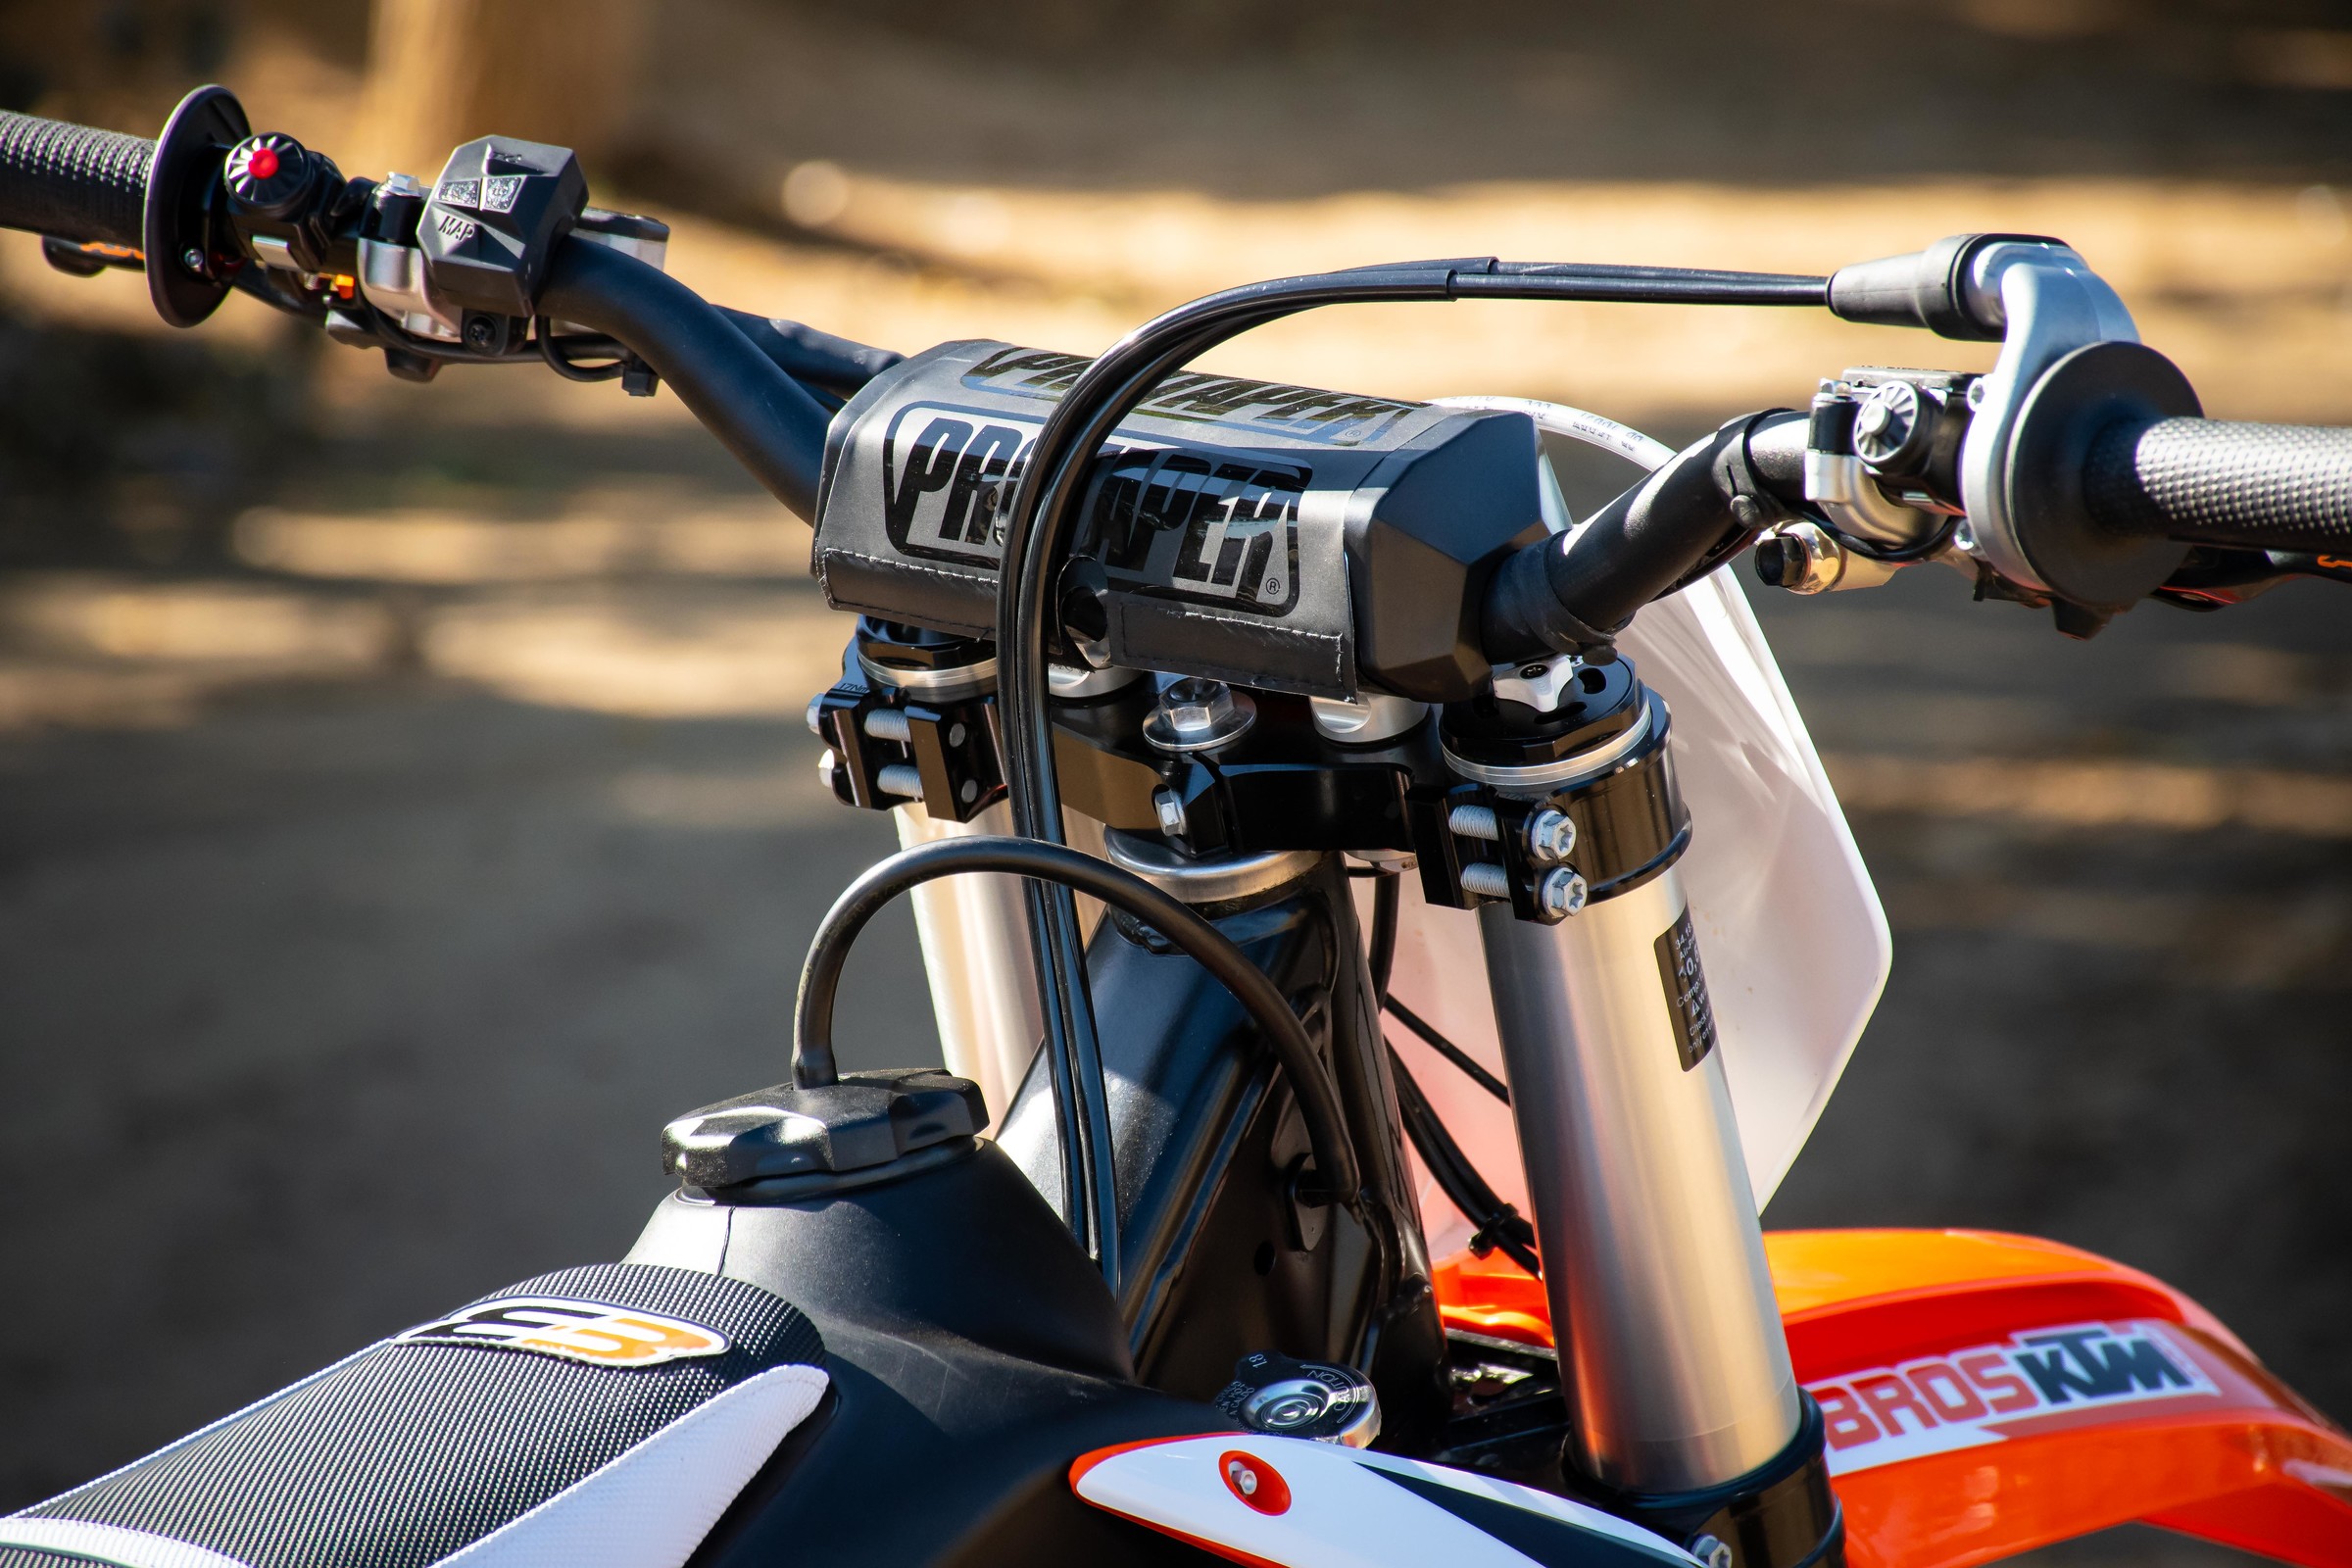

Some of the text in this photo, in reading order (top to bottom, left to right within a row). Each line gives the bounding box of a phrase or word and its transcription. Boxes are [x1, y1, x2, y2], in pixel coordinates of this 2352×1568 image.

[438, 215, 475, 241] MAP
[895, 416, 1286, 601] PRAPER
[1306, 1370, 1349, 1412] CAUTION
[2015, 1329, 2193, 1404] KTM
